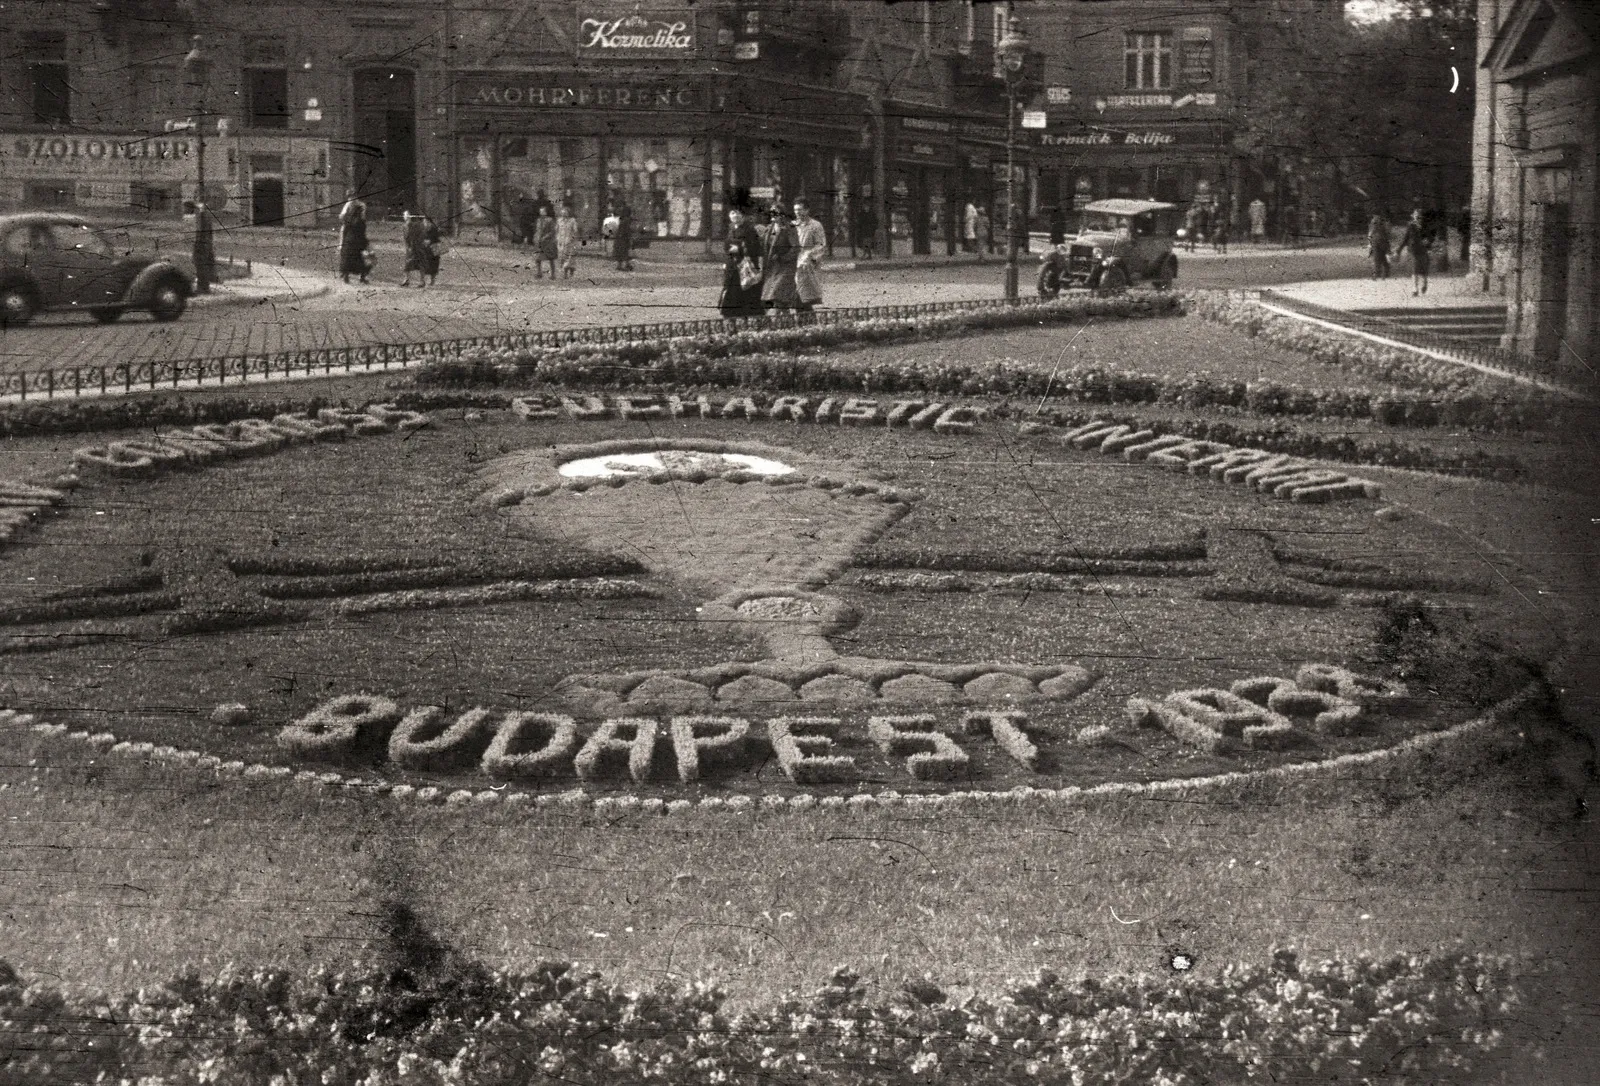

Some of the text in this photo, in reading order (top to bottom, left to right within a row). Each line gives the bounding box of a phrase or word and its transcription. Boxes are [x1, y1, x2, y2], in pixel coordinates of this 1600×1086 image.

[580, 17, 693, 48] Kozmetika
[577, 87, 693, 106] FERENC
[274, 661, 1411, 784] BUDAPEST 1938
